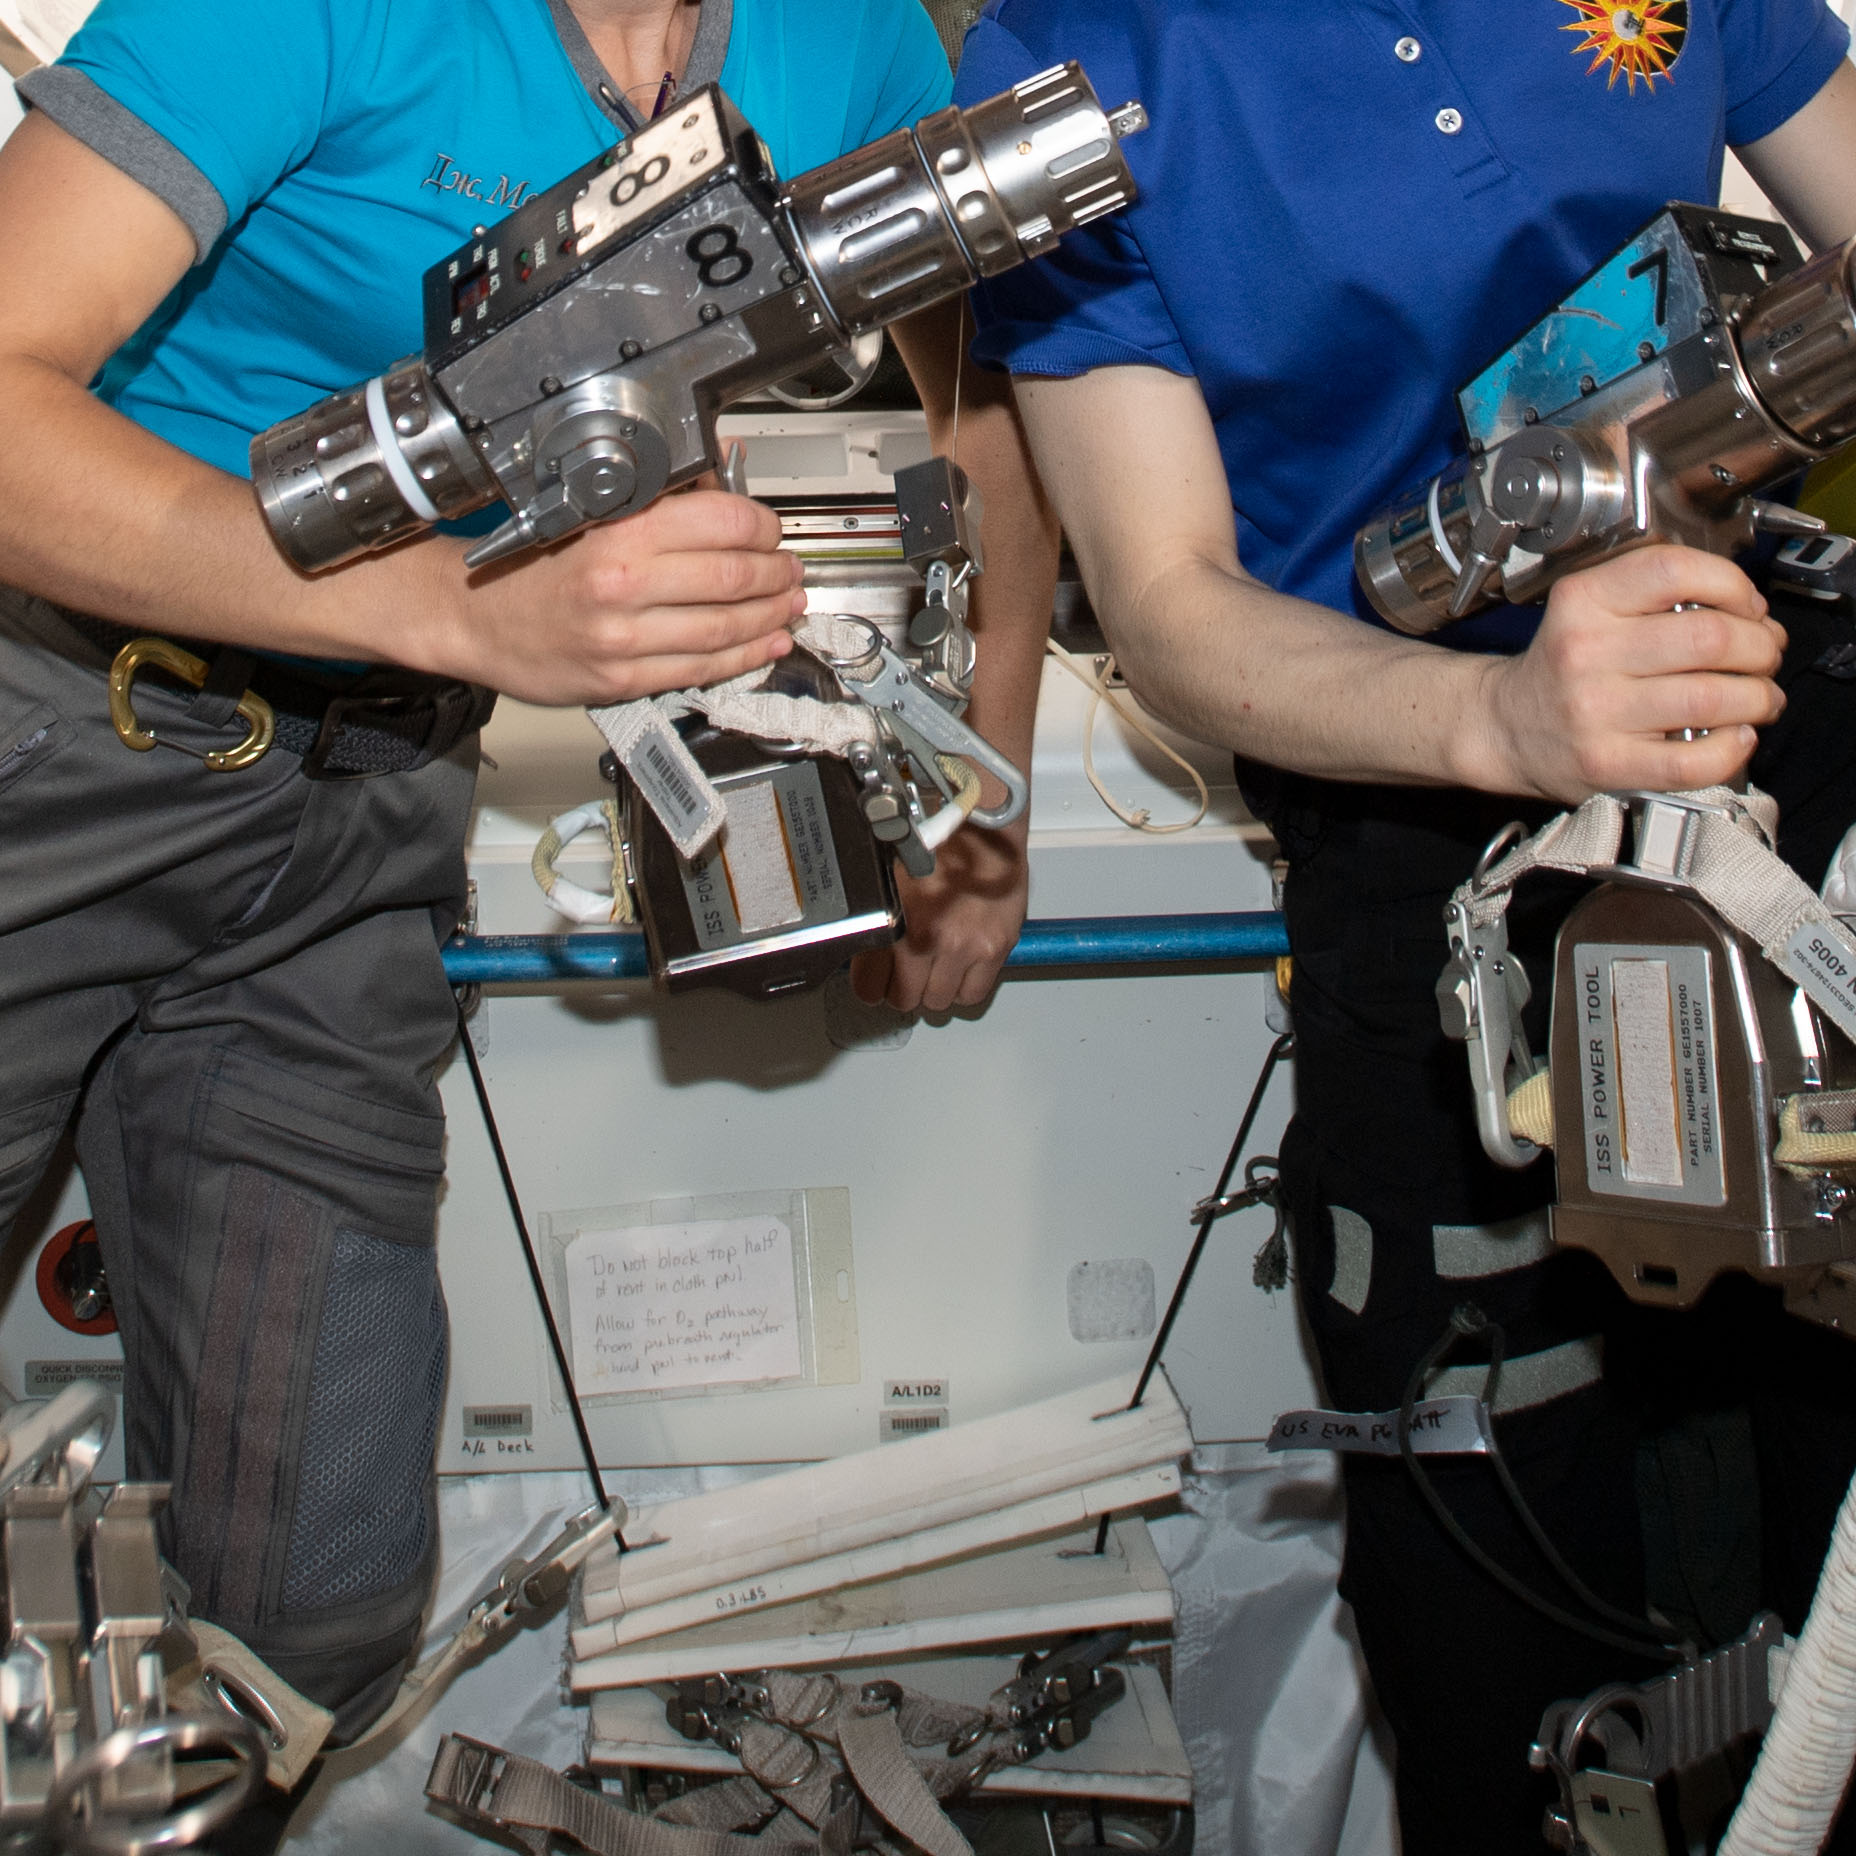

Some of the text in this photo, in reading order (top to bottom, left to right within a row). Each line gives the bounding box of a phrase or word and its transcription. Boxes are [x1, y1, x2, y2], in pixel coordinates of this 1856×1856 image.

[609, 153, 672, 208] 8
[685, 223, 754, 288] 8
[1627, 247, 1668, 326] 7
[704, 910, 725, 938] ISS
[1810, 936, 1850, 977] 4005
[1585, 964, 1613, 1174] ISS POWER TOOL
[1678, 983, 1699, 1167] PART NUMBER GE1557000
[1693, 999, 1713, 1154] SERIAL NUMBER 1007
[585, 1253, 615, 1277] Do
[657, 1247, 700, 1269] block
[744, 1229, 778, 1257] half
[655, 1280, 669, 1294] in
[672, 1275, 707, 1294] cloth
[595, 1313, 635, 1334] Allow
[646, 1309, 667, 1326] for
[705, 1304, 769, 1327] pathway
[595, 1338, 633, 1355] from
[34, 1374, 77, 1384] OXYGEN
[41, 1364, 73, 1374] QUICK
[891, 1384, 942, 1398] A/L1D2
[497, 1438, 535, 1453] Deck
[1281, 1421, 1309, 1438] US
[1320, 1421, 1361, 1440] EVA
